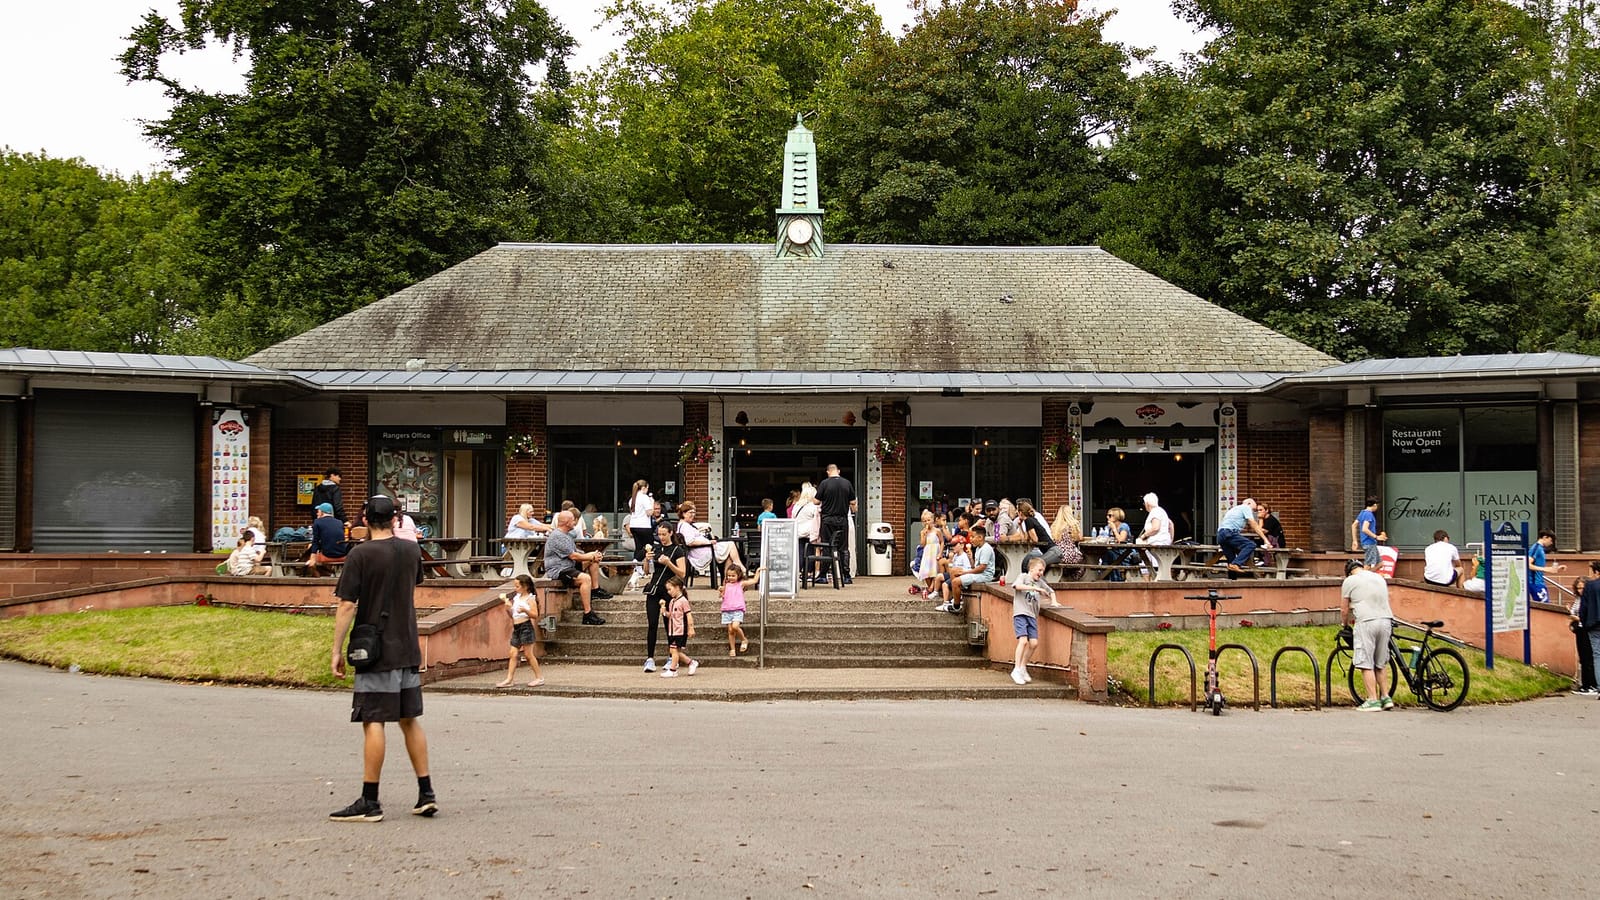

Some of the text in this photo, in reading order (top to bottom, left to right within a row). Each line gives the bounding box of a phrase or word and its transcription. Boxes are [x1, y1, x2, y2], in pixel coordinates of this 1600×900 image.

[383, 432, 410, 440] Rangers
[1392, 429, 1442, 438] Restaurant
[1392, 437, 1441, 447] Now Open
[1475, 494, 1535, 506] ITALIAN
[1387, 496, 1453, 520] Ferraiolo's
[1479, 509, 1531, 521] BISTRO
